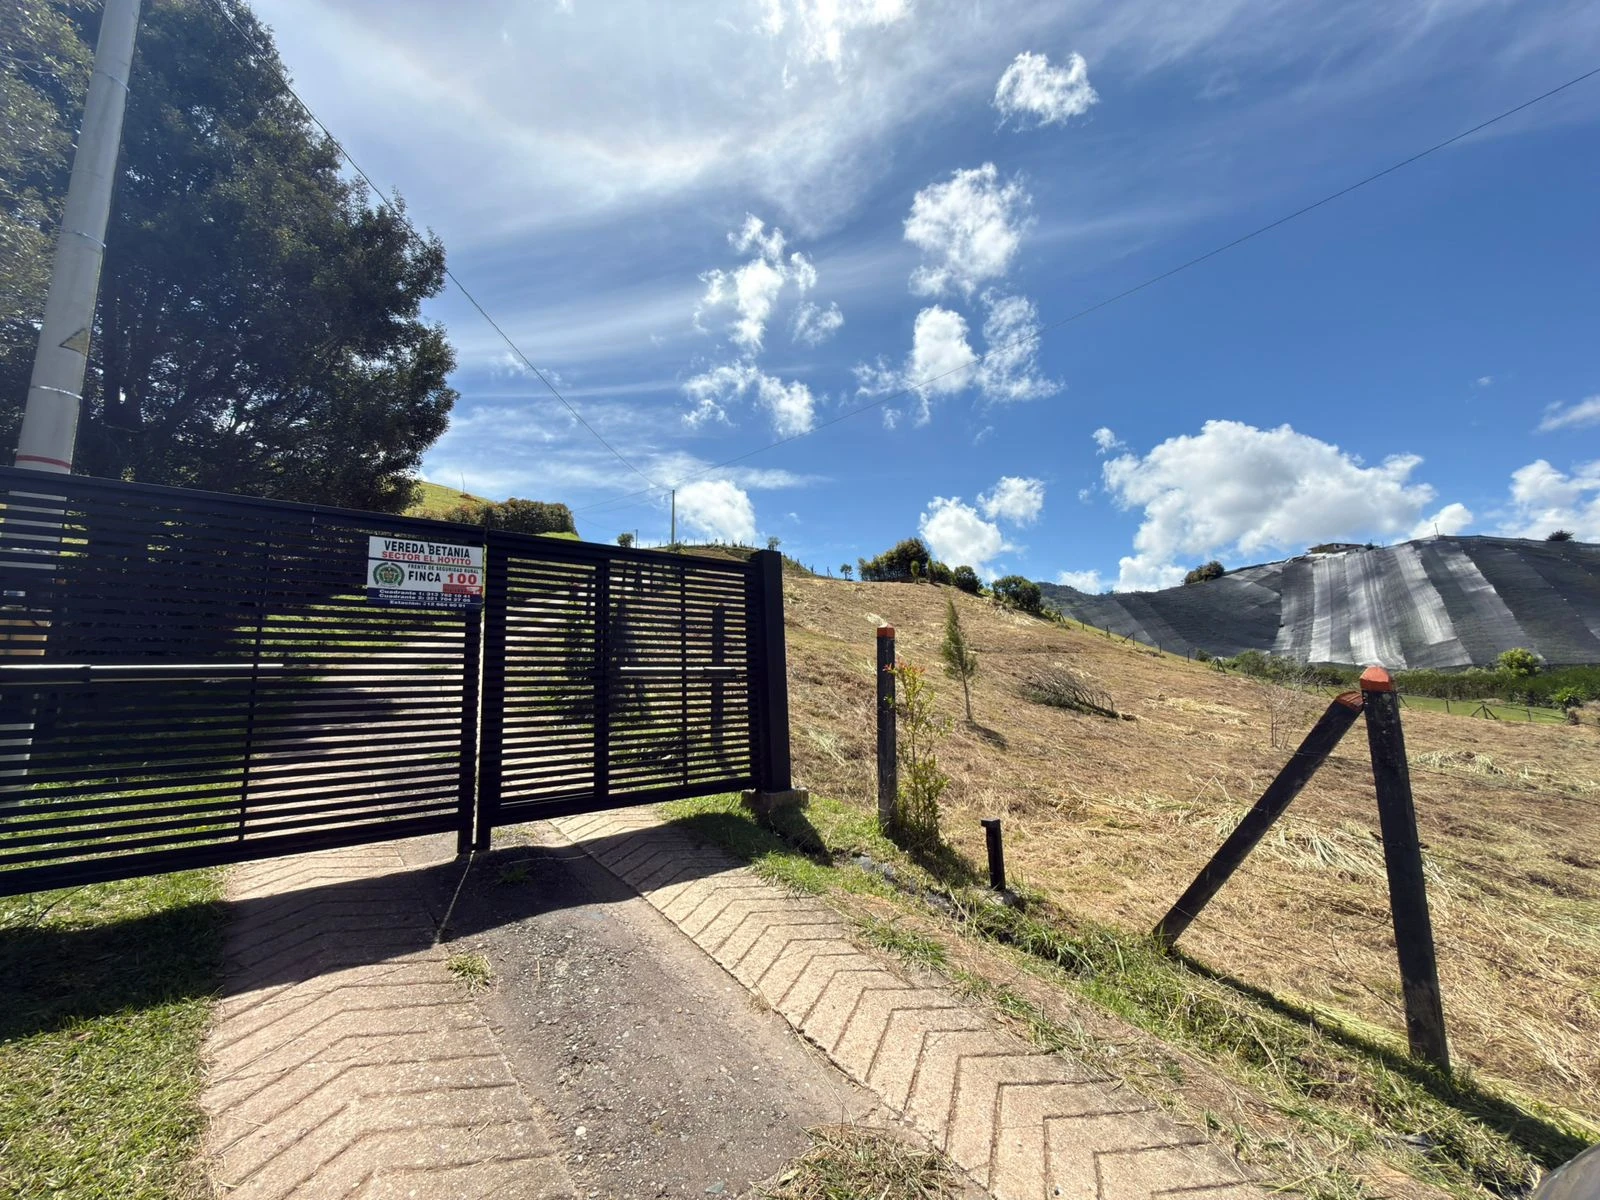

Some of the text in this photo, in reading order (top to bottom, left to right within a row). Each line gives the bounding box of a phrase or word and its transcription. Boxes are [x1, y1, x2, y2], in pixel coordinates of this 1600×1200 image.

[384, 540, 470, 558] VEREDA BETANIA
[382, 551, 420, 562] SECTOR
[438, 556, 471, 565] HOYITO
[408, 571, 477, 585] FINCA 100
